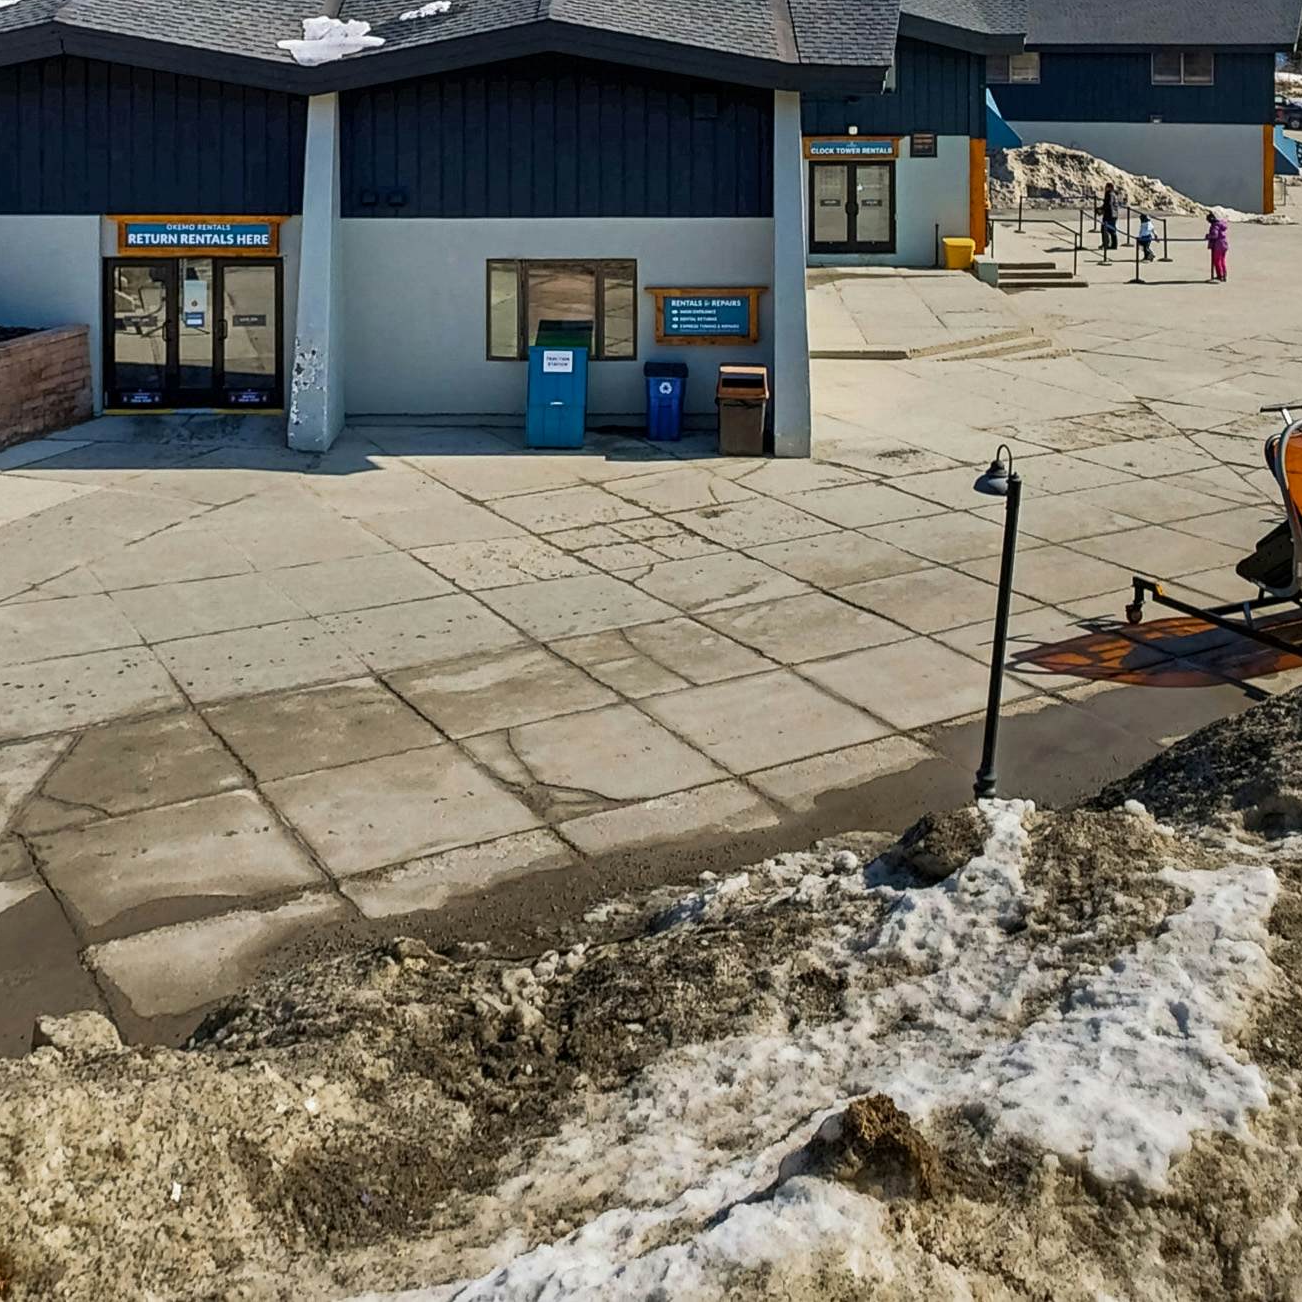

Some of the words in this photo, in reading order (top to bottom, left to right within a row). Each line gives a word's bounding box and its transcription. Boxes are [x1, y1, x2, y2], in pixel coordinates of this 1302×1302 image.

[810, 147, 834, 155] CLOCK
[837, 147, 860, 155] TOWER
[861, 147, 893, 155] RENTALS
[128, 233, 178, 245] RETURN
[180, 233, 234, 245] RENTALS
[236, 233, 269, 245] HERE
